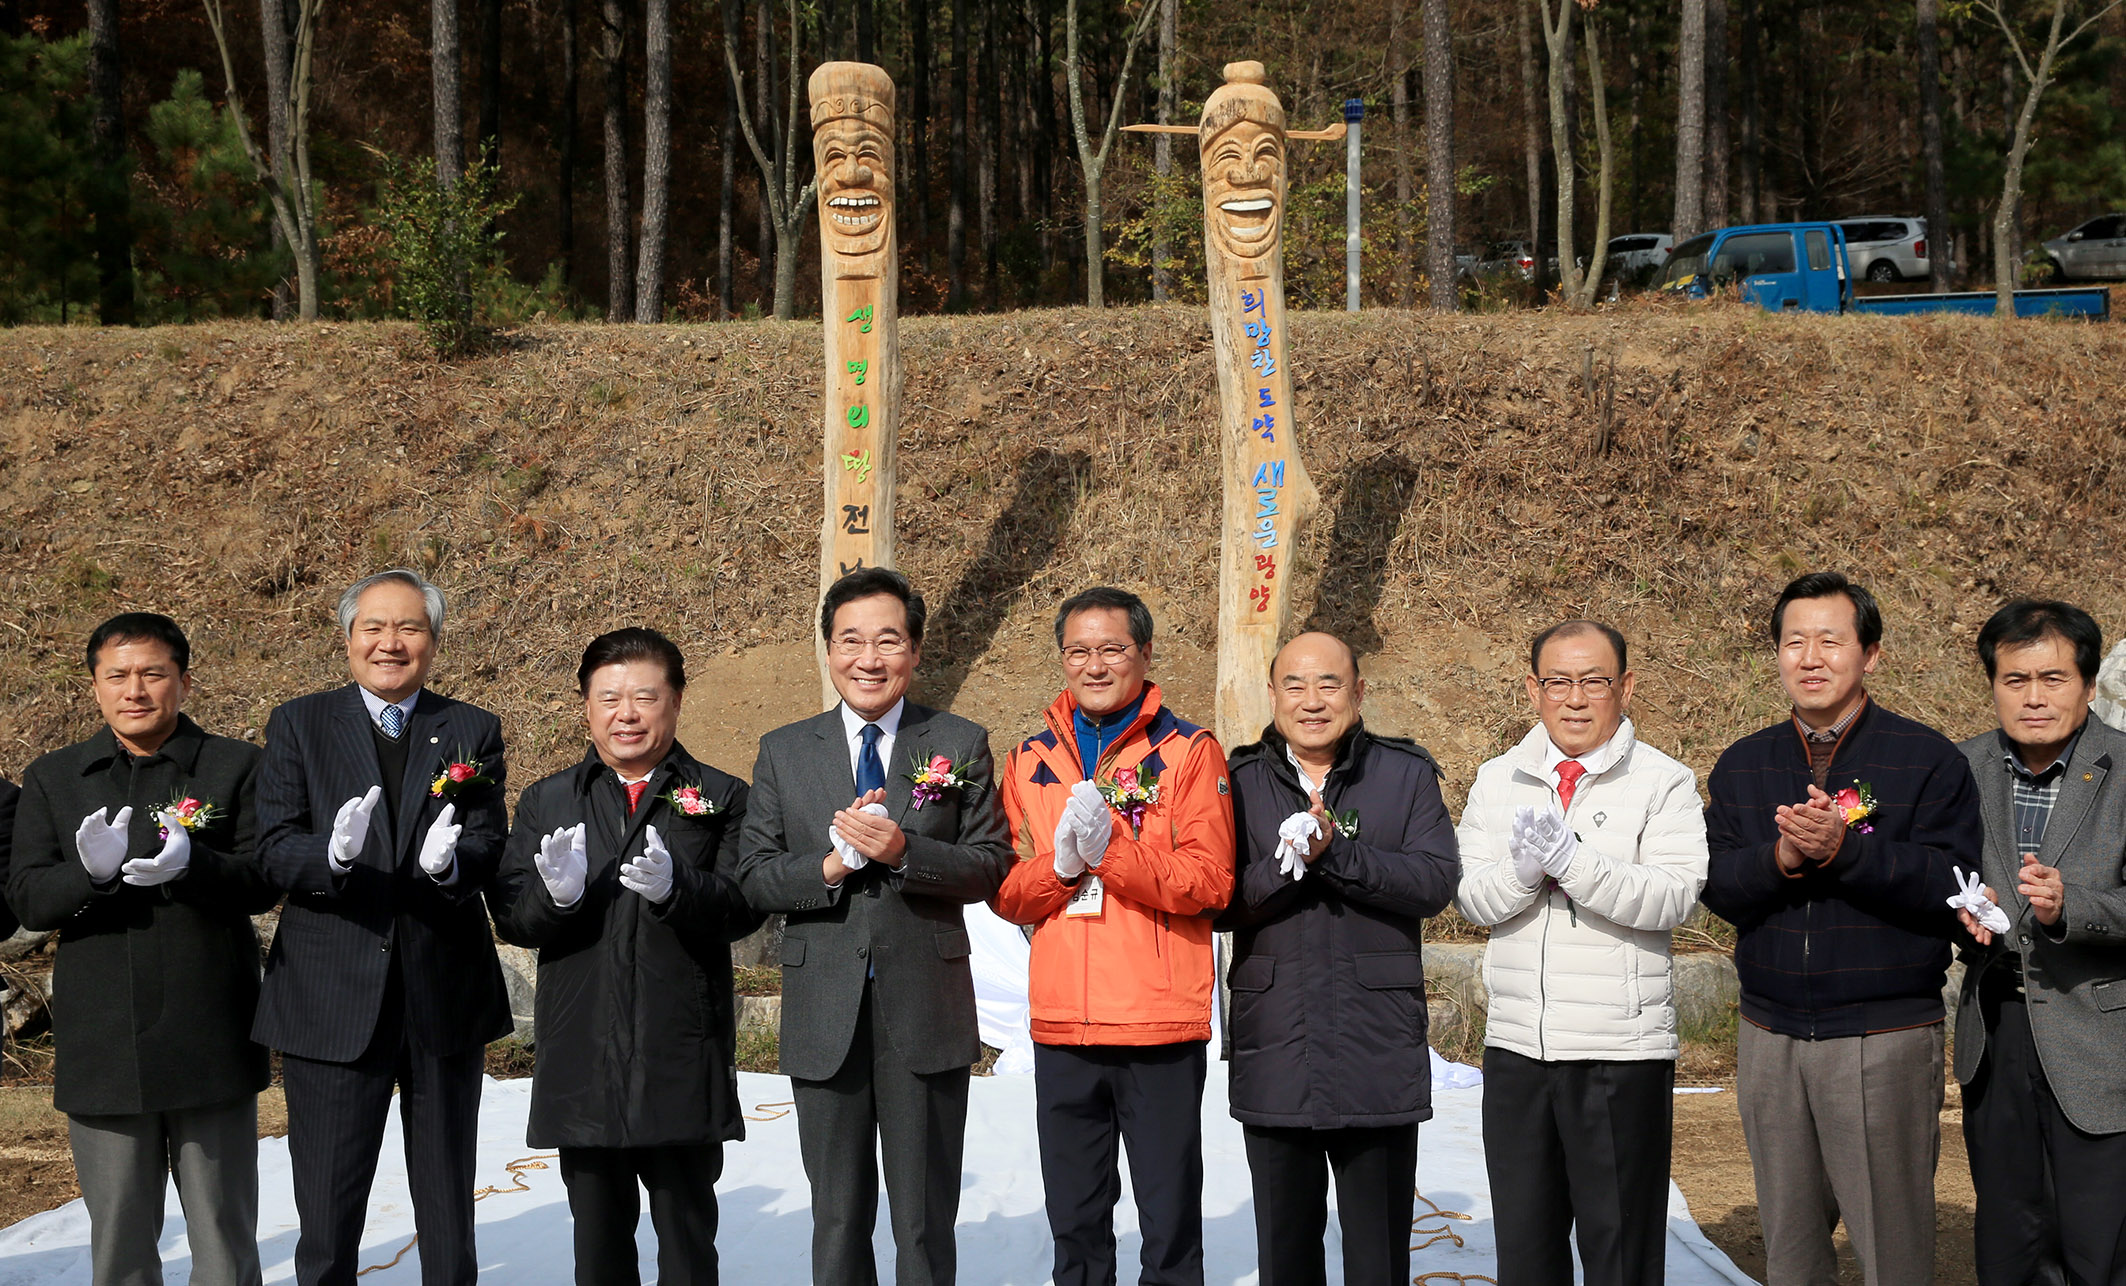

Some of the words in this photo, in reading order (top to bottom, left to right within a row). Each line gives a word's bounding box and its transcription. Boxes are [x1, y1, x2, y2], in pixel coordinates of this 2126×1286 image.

[846, 304, 873, 429] 생명의
[1241, 288, 1276, 377] 희망찬
[1252, 387, 1276, 443] 도약
[1252, 459, 1285, 549] 새로운
[1250, 554, 1276, 612] 광양
